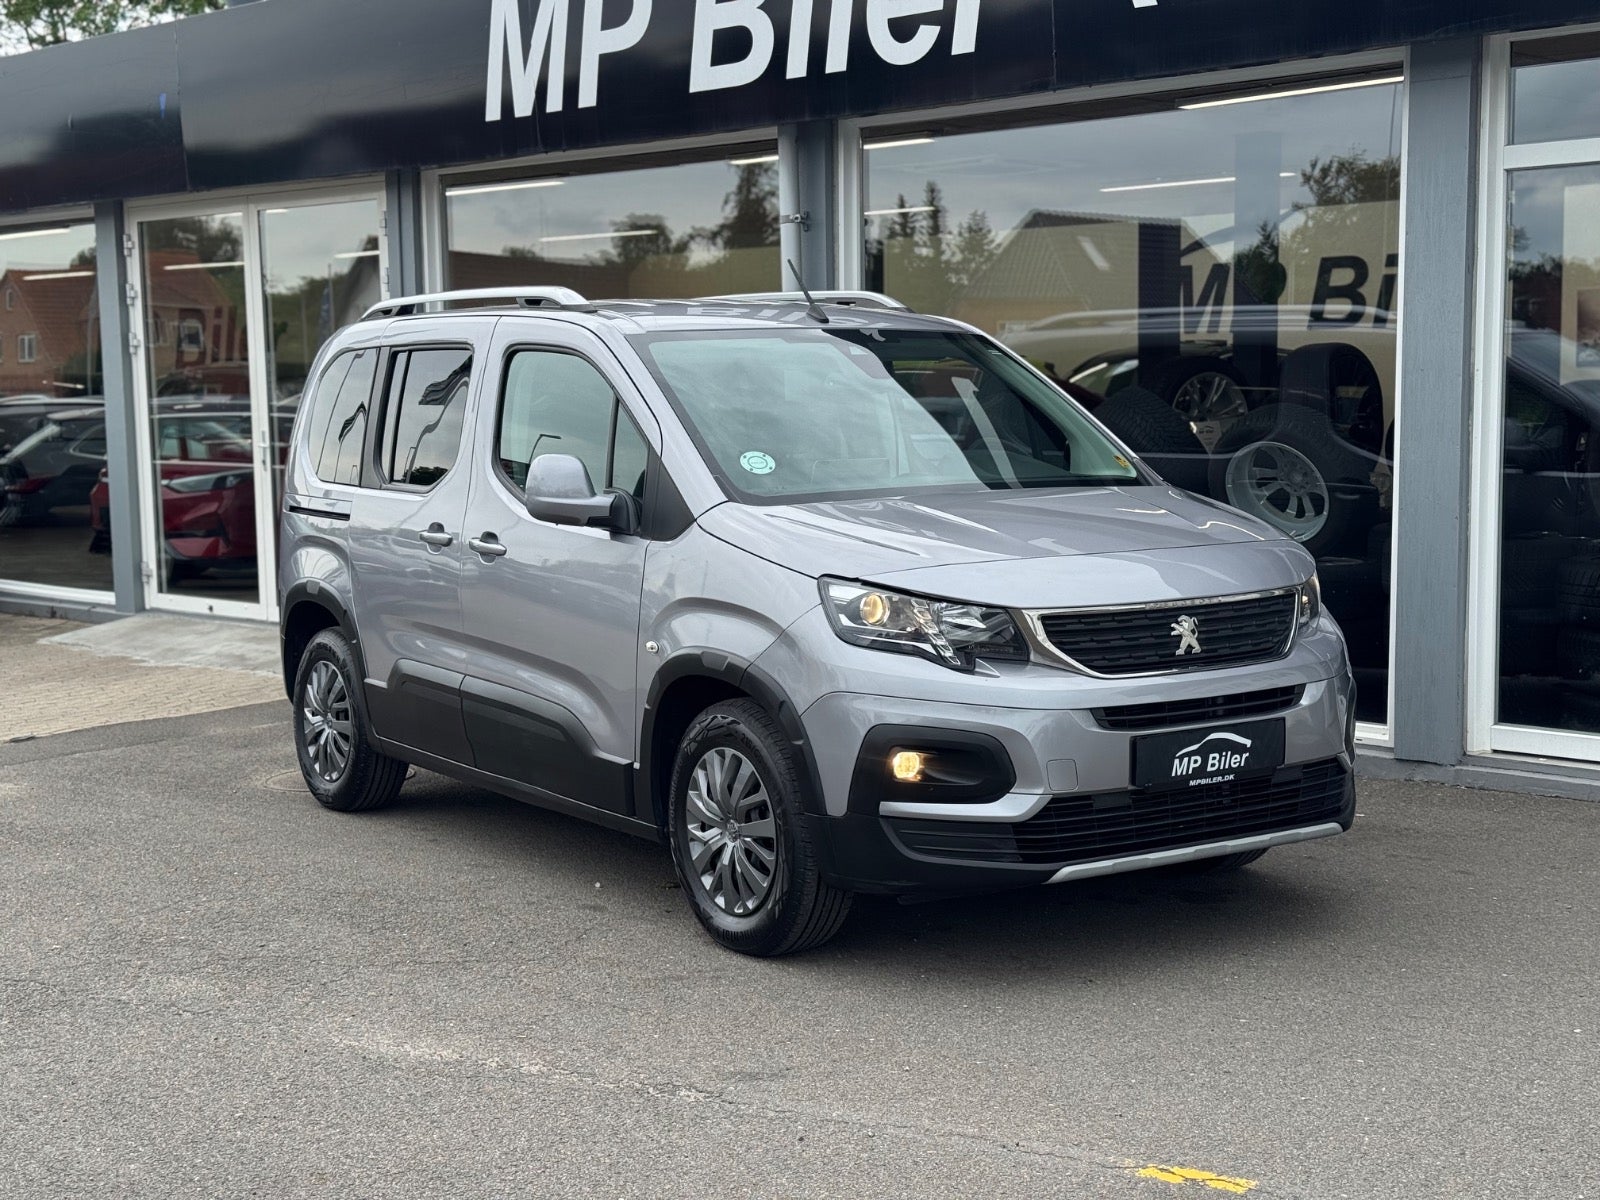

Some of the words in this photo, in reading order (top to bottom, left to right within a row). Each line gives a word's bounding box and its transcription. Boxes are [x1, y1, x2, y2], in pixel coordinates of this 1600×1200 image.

[485, 0, 651, 122] MP
[1171, 756, 1201, 777] MP
[1207, 751, 1249, 772] Biler
[1189, 774, 1235, 787] MPBILER.DK
